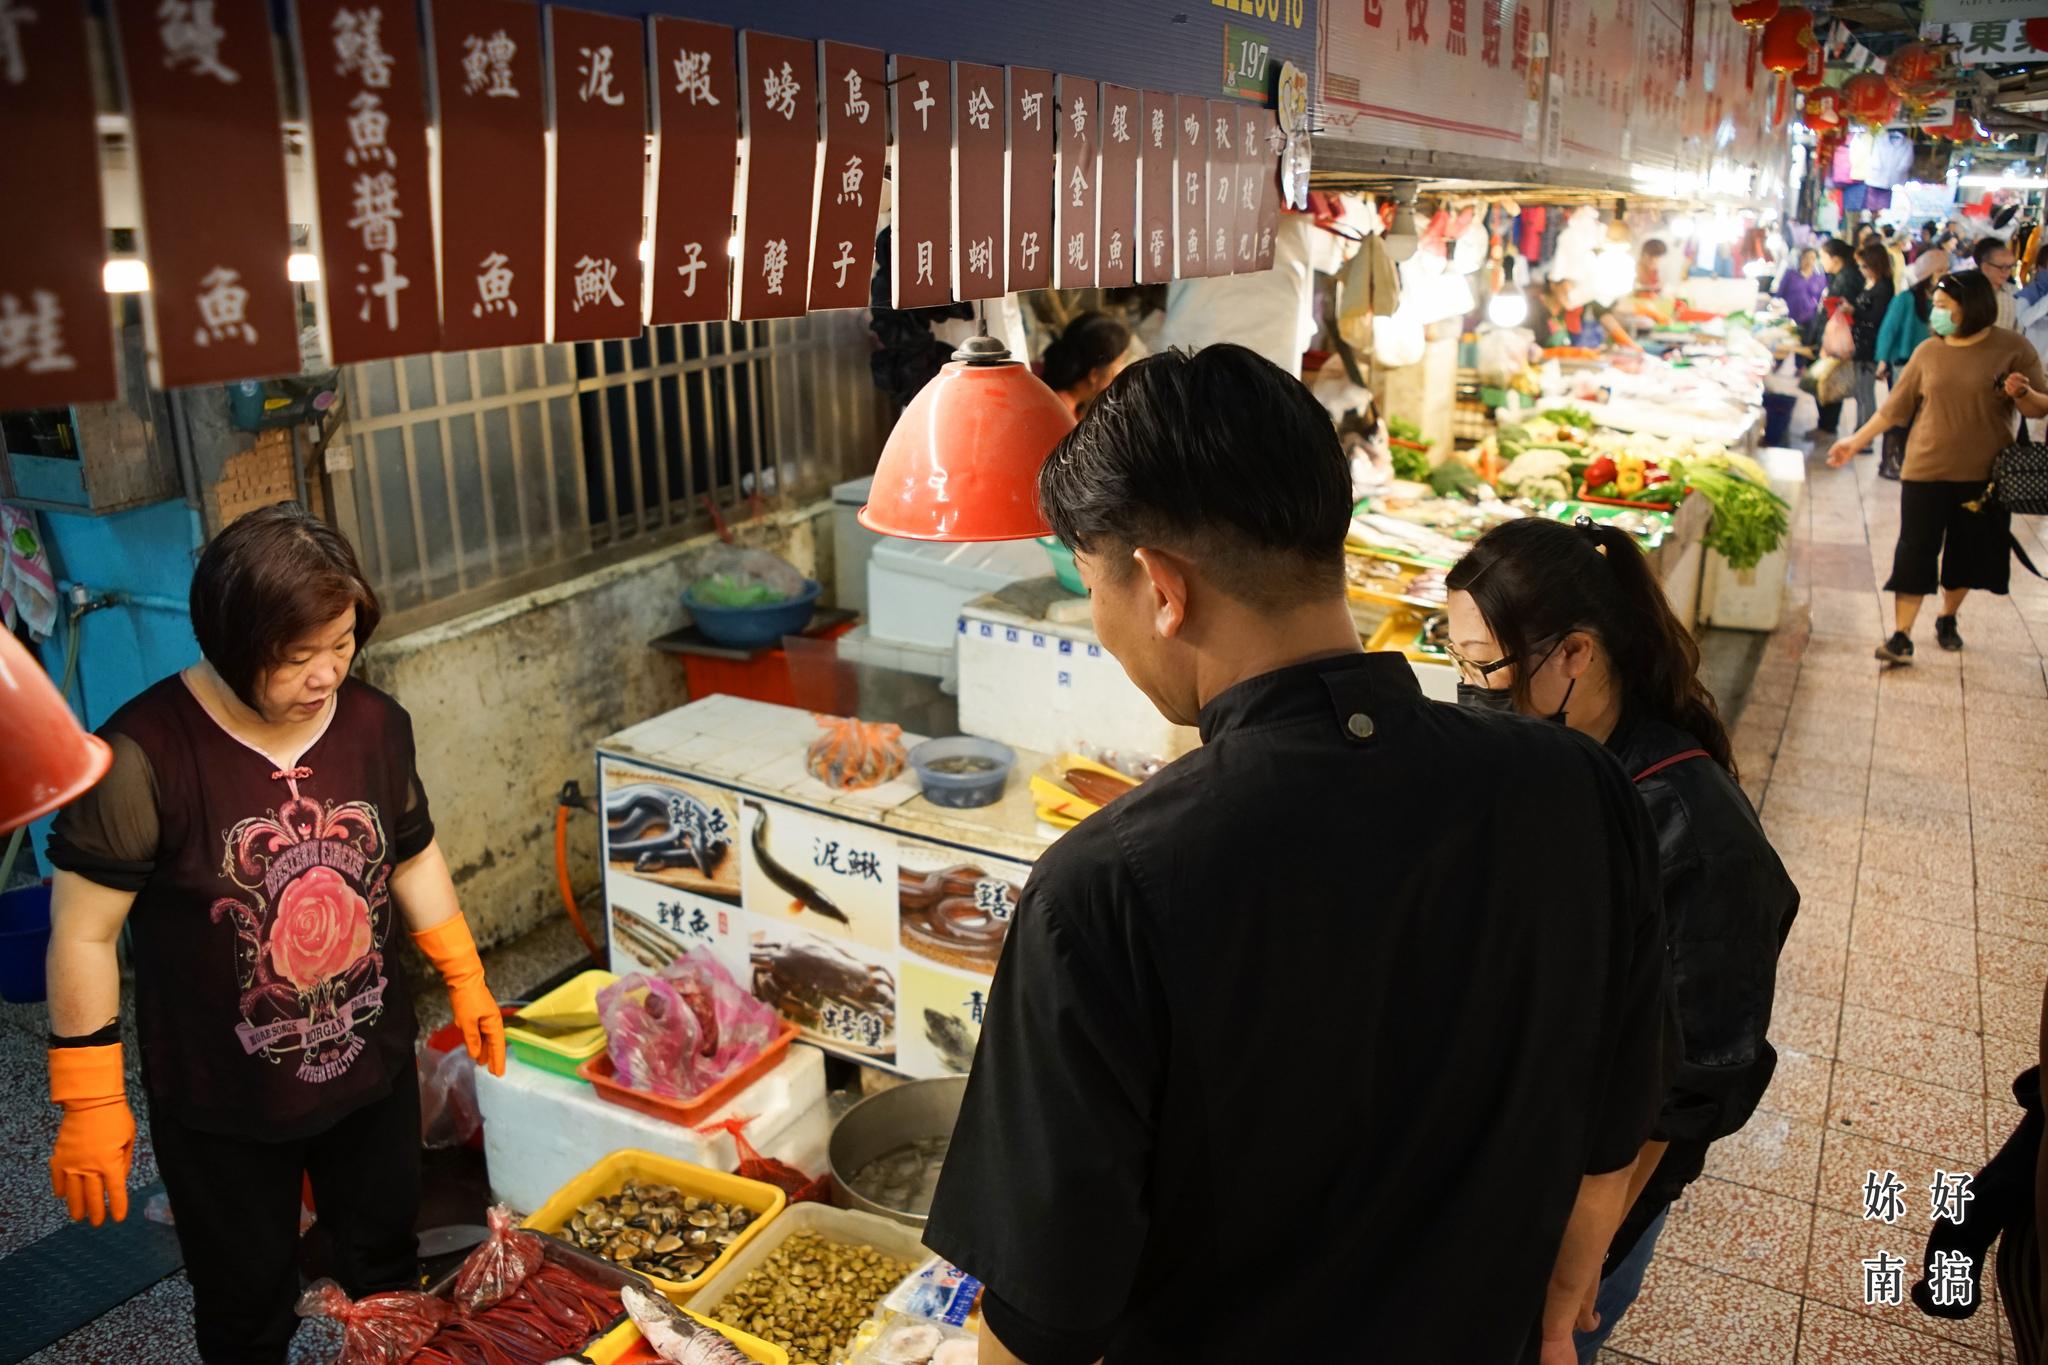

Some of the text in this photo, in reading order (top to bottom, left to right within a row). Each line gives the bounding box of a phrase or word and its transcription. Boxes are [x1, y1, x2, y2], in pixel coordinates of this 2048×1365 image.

[1238, 40, 1269, 81] 197
[330, 5, 409, 331] 鱔魚醬汁
[673, 48, 721, 299] 蝦子
[762, 61, 801, 297] 螃蟹
[832, 67, 870, 289] 烏魚子
[912, 79, 936, 287] 干貝
[967, 85, 995, 280] 蛤蜊
[1020, 88, 1044, 272] 蚵仔
[1107, 104, 1131, 270] 銀魚
[657, 900, 714, 943] 鱧魚
[813, 837, 883, 884] 泥鰍
[249, 1021, 297, 1046] MORE SONGS
[306, 1017, 346, 1045] MORGAN
[821, 1006, 884, 1050] 螃蟹
